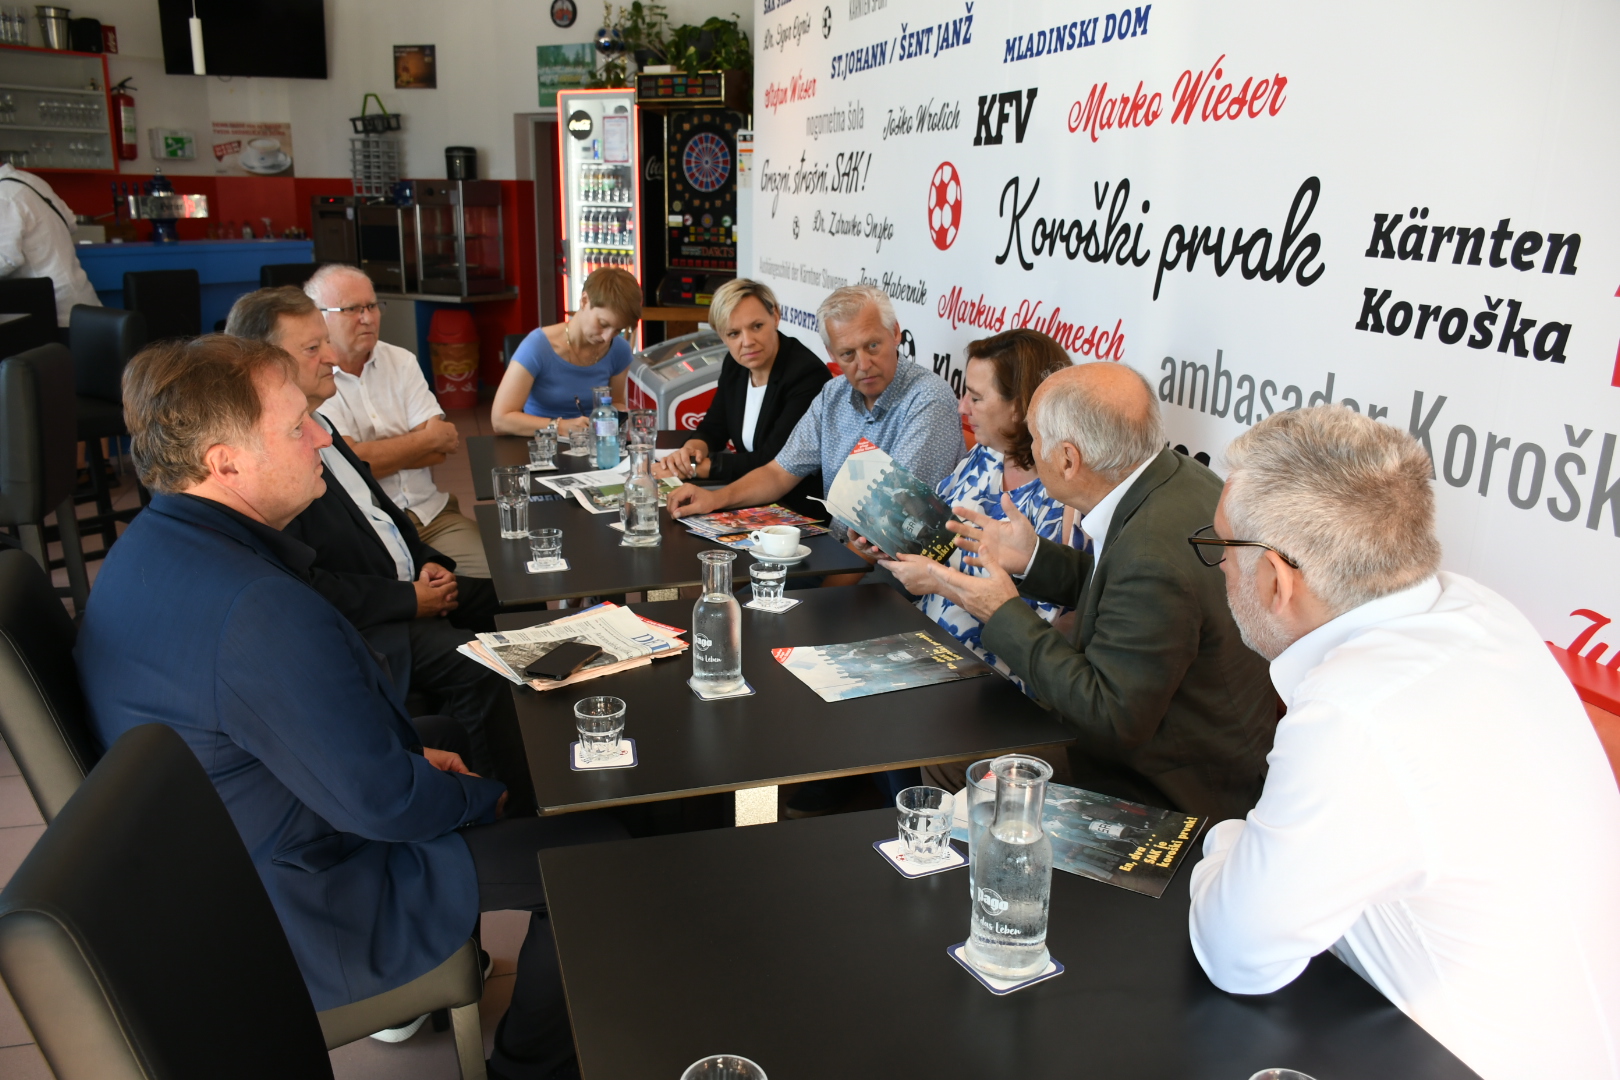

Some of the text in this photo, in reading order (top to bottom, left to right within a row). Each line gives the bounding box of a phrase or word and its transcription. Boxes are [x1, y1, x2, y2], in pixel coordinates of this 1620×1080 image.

[831, 40, 888, 80] ST.JOHANN
[899, 22, 934, 61] ŠENT
[933, 1, 975, 58] JANŽ
[1003, 4, 1151, 64] MLADINSKI DOM
[789, 68, 817, 103] Wieser
[1068, 54, 1288, 143] Marko Wieser
[847, 100, 865, 130] šola
[883, 105, 914, 140] Joško
[973, 87, 1038, 146] KFV
[995, 176, 1325, 301] Koroški prvak
[1365, 206, 1582, 276] Kärnten
[781, 304, 820, 333] AK SPORTPA
[937, 285, 1125, 361] Markus Kulmesch
[1355, 287, 1573, 364] Koroška
[1119, 861, 1138, 872] En,
[1129, 846, 1146, 860] dva
[1144, 841, 1171, 865] SAK je
[1156, 816, 1198, 868] koroški prvak!
[977, 887, 1008, 911] pago
[995, 922, 1021, 934] Leben
